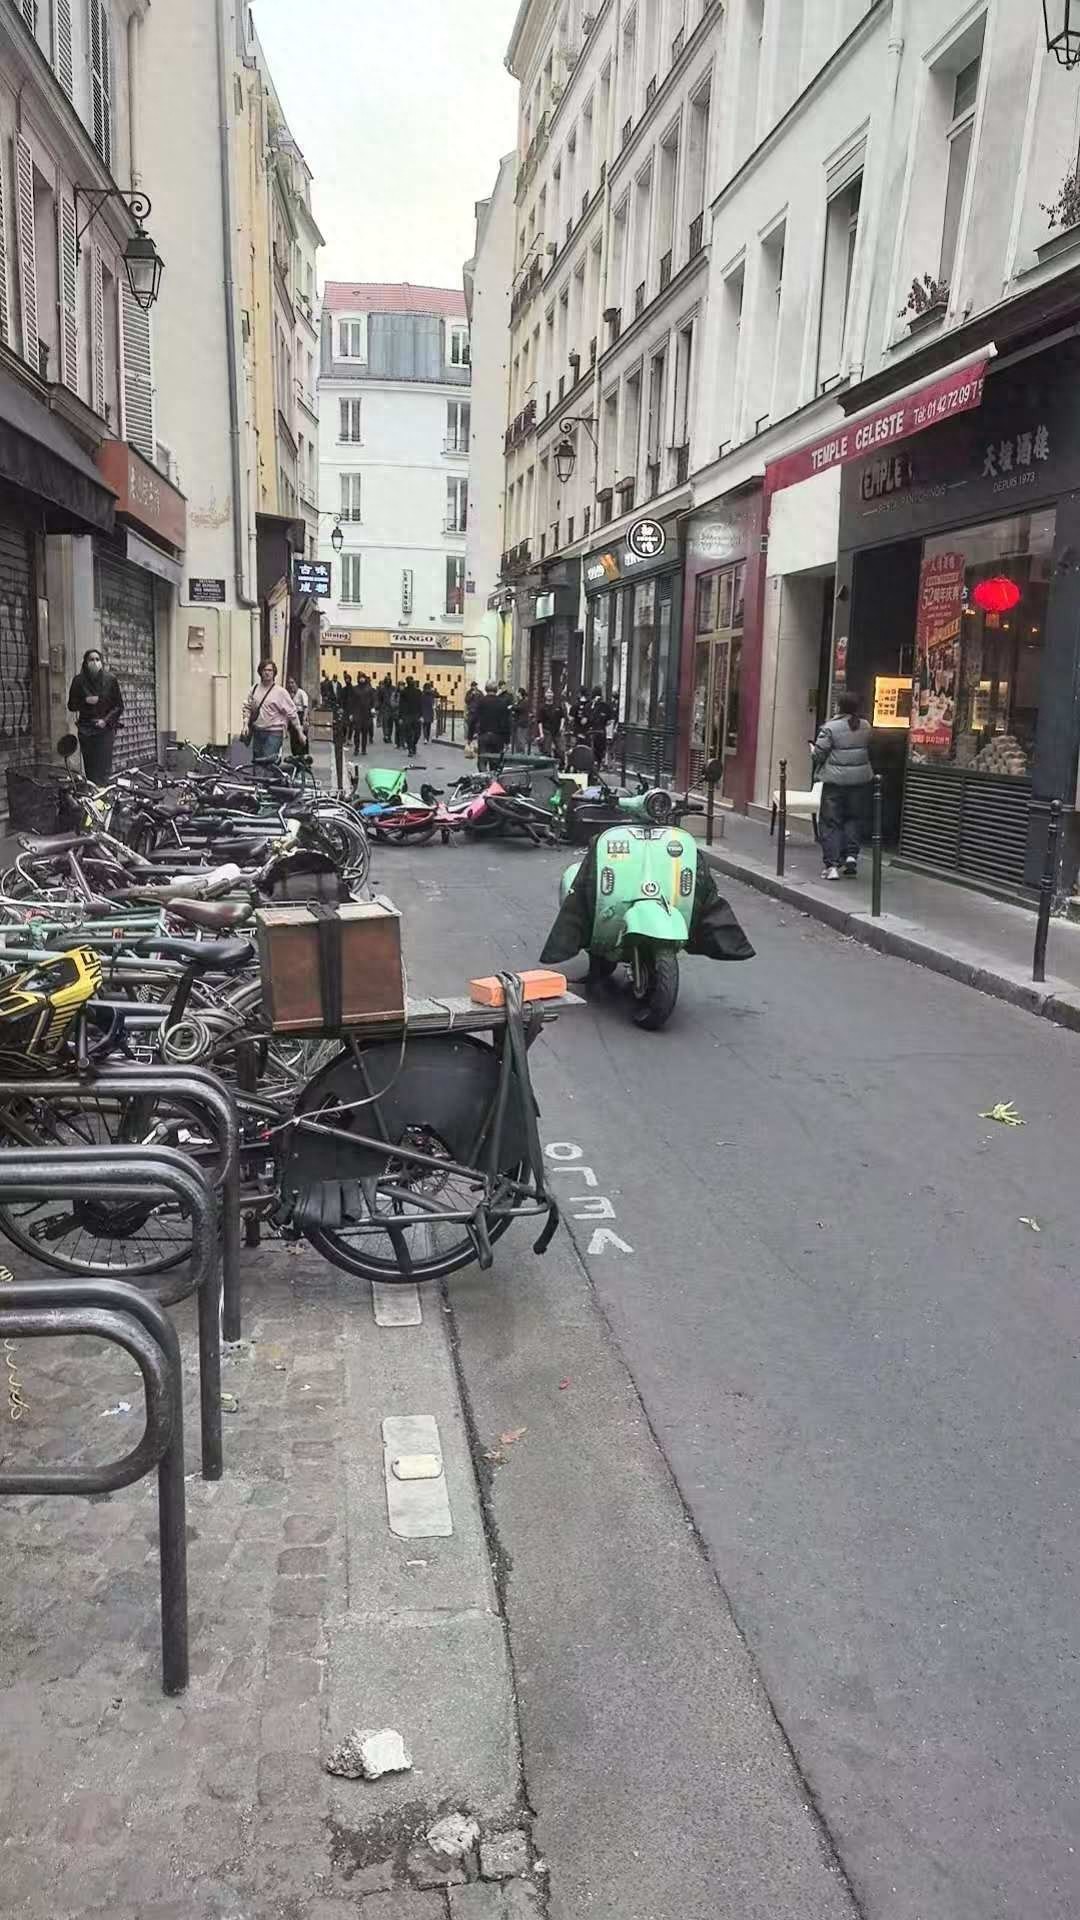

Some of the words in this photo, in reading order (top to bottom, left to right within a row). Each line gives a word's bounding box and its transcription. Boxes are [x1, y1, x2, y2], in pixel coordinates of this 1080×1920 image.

[811, 436, 848, 470] TEMPLE
[855, 410, 905, 450] CELESTE
[392, 633, 435, 642] TANGO
